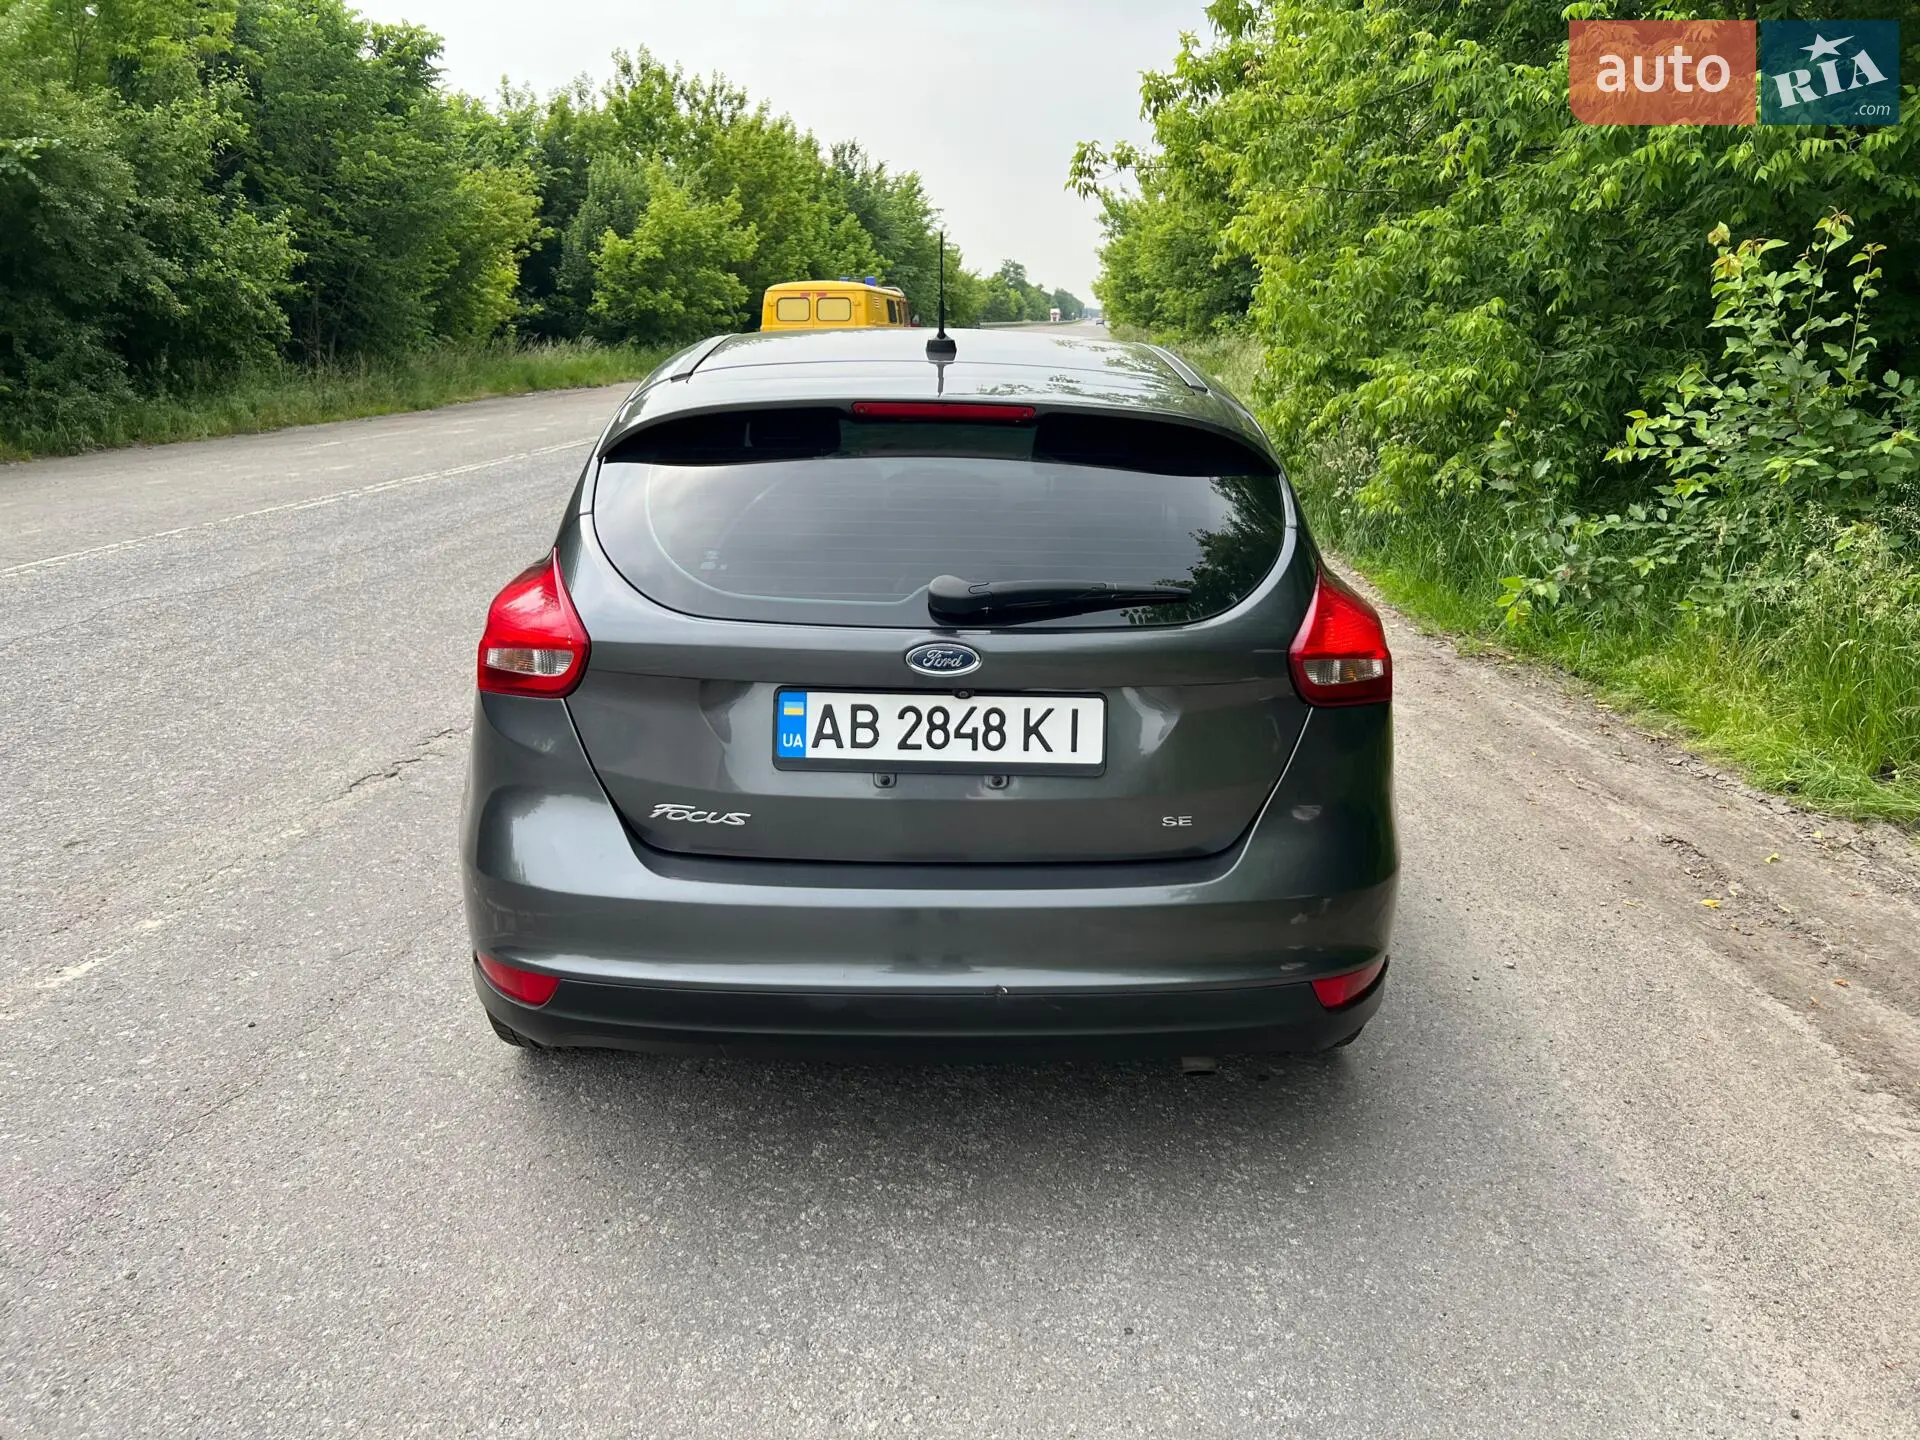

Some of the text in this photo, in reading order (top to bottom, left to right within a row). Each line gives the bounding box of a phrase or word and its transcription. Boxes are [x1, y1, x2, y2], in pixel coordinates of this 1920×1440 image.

[922, 649, 963, 668] Ford
[811, 703, 880, 749] AB
[897, 705, 1007, 751] 2848
[782, 734, 804, 747] UA
[1162, 815, 1193, 827] SE
